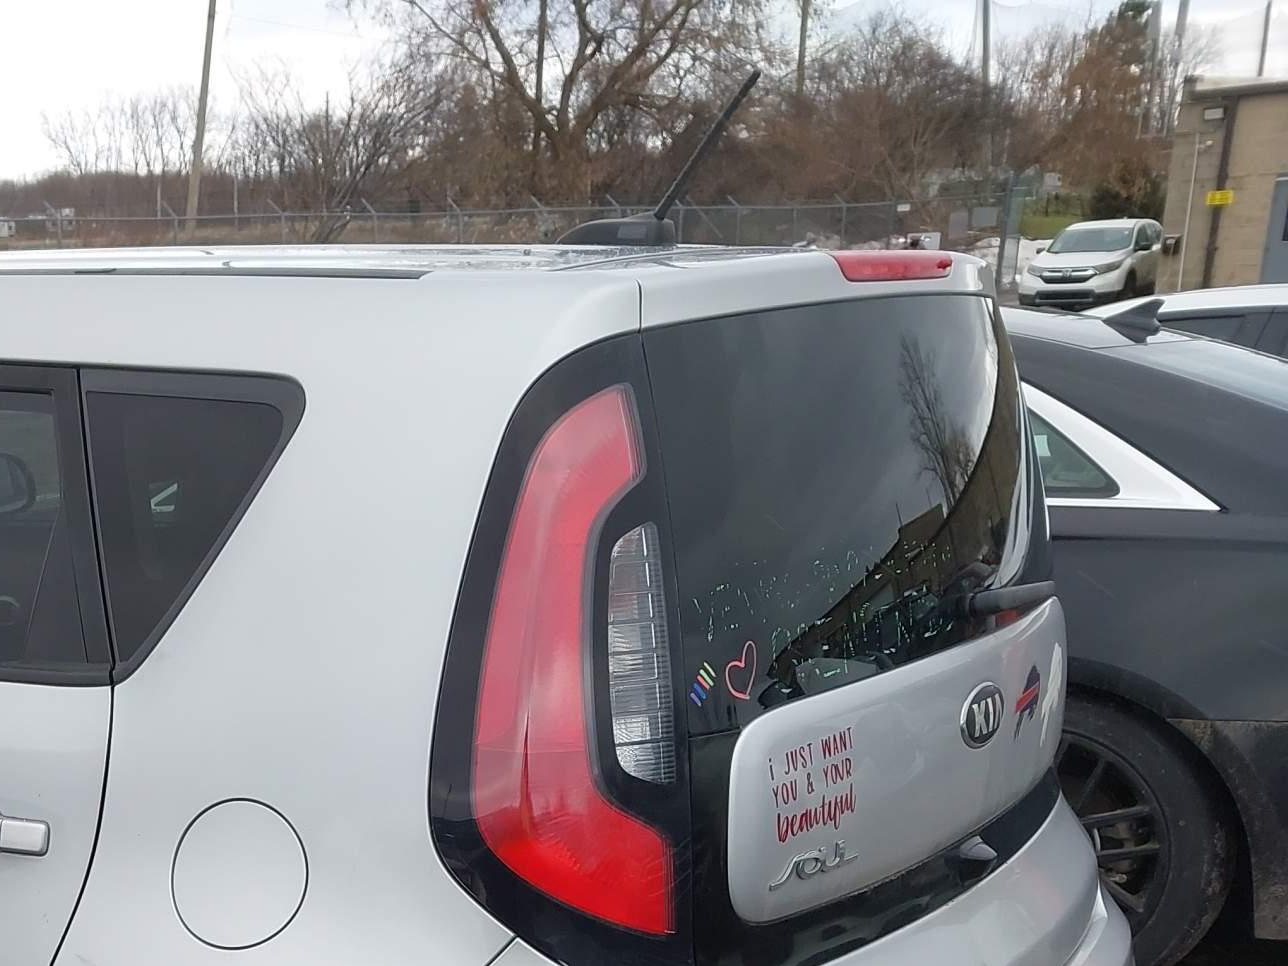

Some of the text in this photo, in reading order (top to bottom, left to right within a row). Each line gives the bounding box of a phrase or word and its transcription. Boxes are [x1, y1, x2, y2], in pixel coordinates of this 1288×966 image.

[784, 742, 814, 775] JUST
[820, 726, 853, 760] WANT
[772, 757, 852, 809] YOU & YOUR
[776, 782, 857, 844] beautiful
